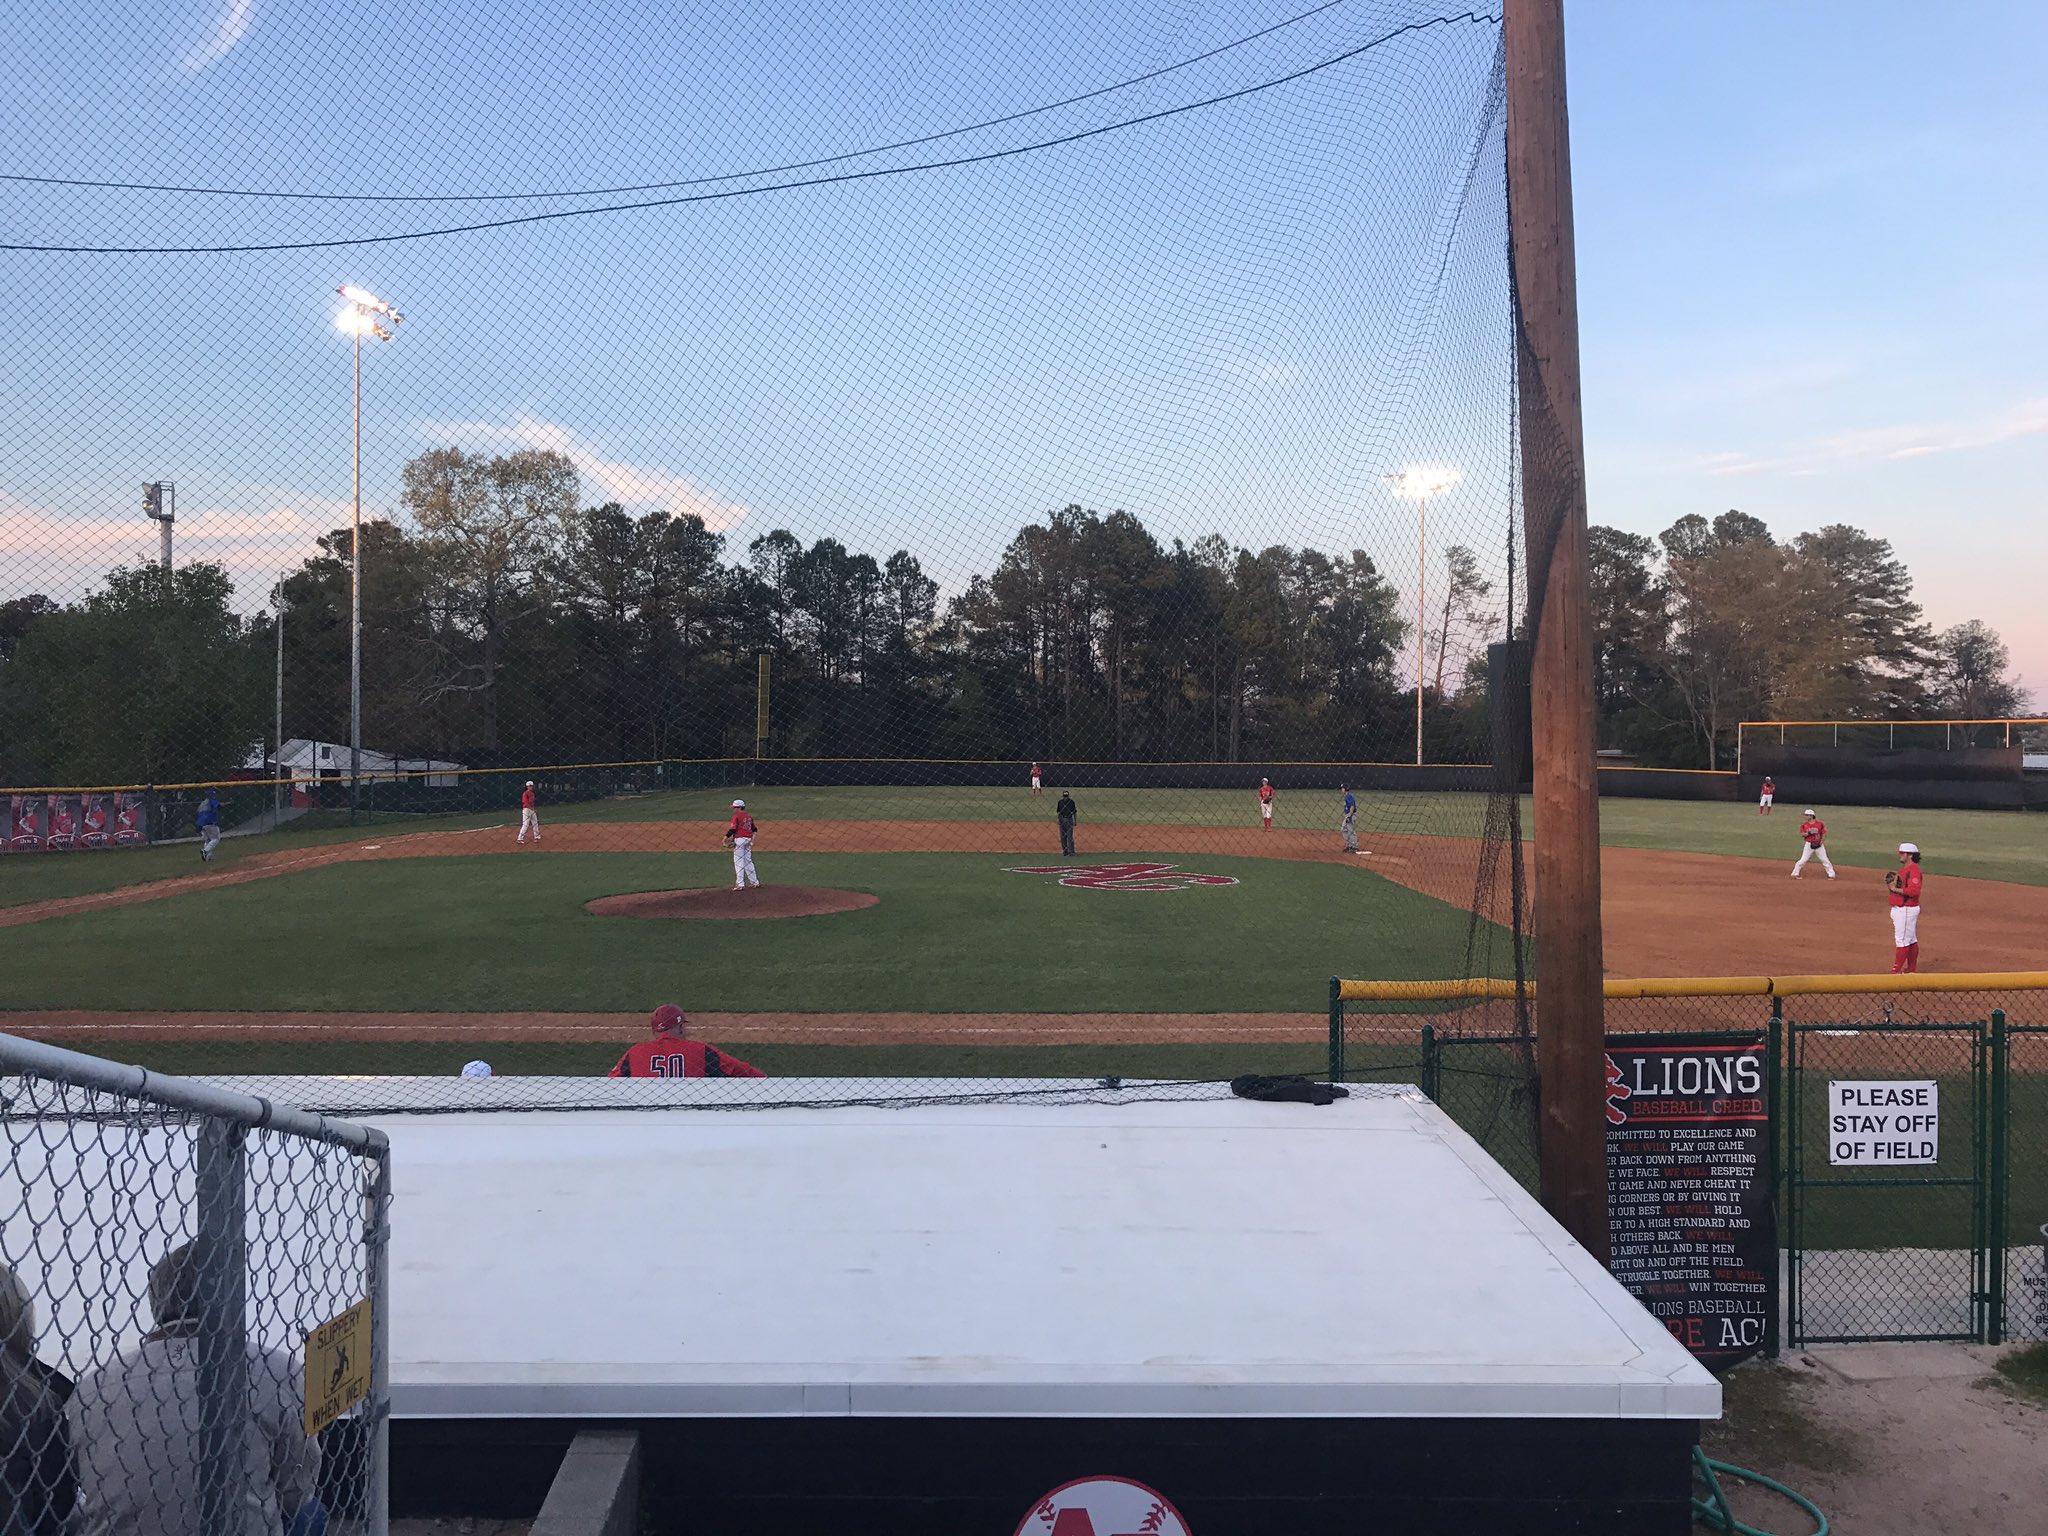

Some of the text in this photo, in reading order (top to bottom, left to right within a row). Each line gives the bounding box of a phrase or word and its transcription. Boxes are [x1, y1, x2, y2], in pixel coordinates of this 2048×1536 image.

[651, 1054, 684, 1077] 50
[1633, 1056, 1760, 1096] LIONS
[1842, 1089, 1928, 1106] PLEASE
[1632, 1099, 1762, 1115] BASEBALL CREED
[1833, 1115, 1936, 1132] STAY OFF
[1606, 1129, 1756, 1140] OMMITTED TO EXCELLENCE AND
[1625, 1143, 1639, 1152] WE
[1643, 1143, 1667, 1151] WILL
[1671, 1143, 1694, 1151] PLAY
[1698, 1142, 1715, 1151] OUR
[1718, 1142, 1744, 1150] GAME
[1836, 1141, 1934, 1159] OF FIELD
[1620, 1156, 1642, 1165] BACK
[1646, 1156, 1674, 1164] DOWN
[1678, 1155, 1702, 1163] FROM
[1705, 1154, 1756, 1163] ANYTHING
[1618, 1169, 1633, 1177] WE
[1664, 1168, 1679, 1177] WE
[1683, 1168, 1708, 1176] WILL
[1711, 1167, 1755, 1176] RESPECT
[1619, 1182, 1644, 1190] GAME
[1647, 1181, 1667, 1189] AND
[1670, 1180, 1701, 1188] NEVER
[1704, 1180, 1737, 1189] CHEAT
[1740, 1180, 1751, 1188] IT
[1619, 1194, 1660, 1202] CORNERS
[1678, 1193, 1689, 1201] BY
[1692, 1193, 1727, 1202] GIVING
[1730, 1193, 1740, 1201] IT
[1618, 1207, 1635, 1216] OUR
[1666, 1206, 1682, 1214] WE
[1686, 1205, 1711, 1214] WILL
[1714, 1206, 1742, 1214] HOLD
[1625, 1220, 1635, 1228] TO
[1639, 1220, 1645, 1228] A
[1649, 1219, 1670, 1227] HIGH
[1674, 1218, 1725, 1227] STANDARD
[1729, 1219, 1750, 1228] AND
[1620, 1232, 1655, 1241] OTHERS
[1686, 1232, 1705, 1240] WE
[1708, 1232, 1734, 1240] WILL
[1620, 1246, 1649, 1255] ABOVE
[1652, 1245, 1669, 1253] ALL
[1673, 1244, 1692, 1253] AND
[1696, 1244, 1708, 1252] BE
[1712, 1244, 1735, 1253] MEN
[1633, 1259, 1645, 1267] ON
[1648, 1258, 1666, 1266] AND
[1670, 1257, 1686, 1266] OFF
[1689, 1257, 1709, 1265] THE
[1616, 1271, 1660, 1282] STRUGGLE
[1715, 1271, 1733, 1279] WE
[1736, 1271, 1764, 1280] WILL
[2024, 1278, 2048, 1286] MUS
[1647, 1285, 1662, 1293] WE
[1664, 1283, 1687, 1293] WILL
[1689, 1283, 1711, 1291] WIN
[1689, 1301, 1765, 1314] BASEBALL
[318, 1308, 361, 1349] SLIPPERY
[312, 1377, 364, 1428] WHEN WET
